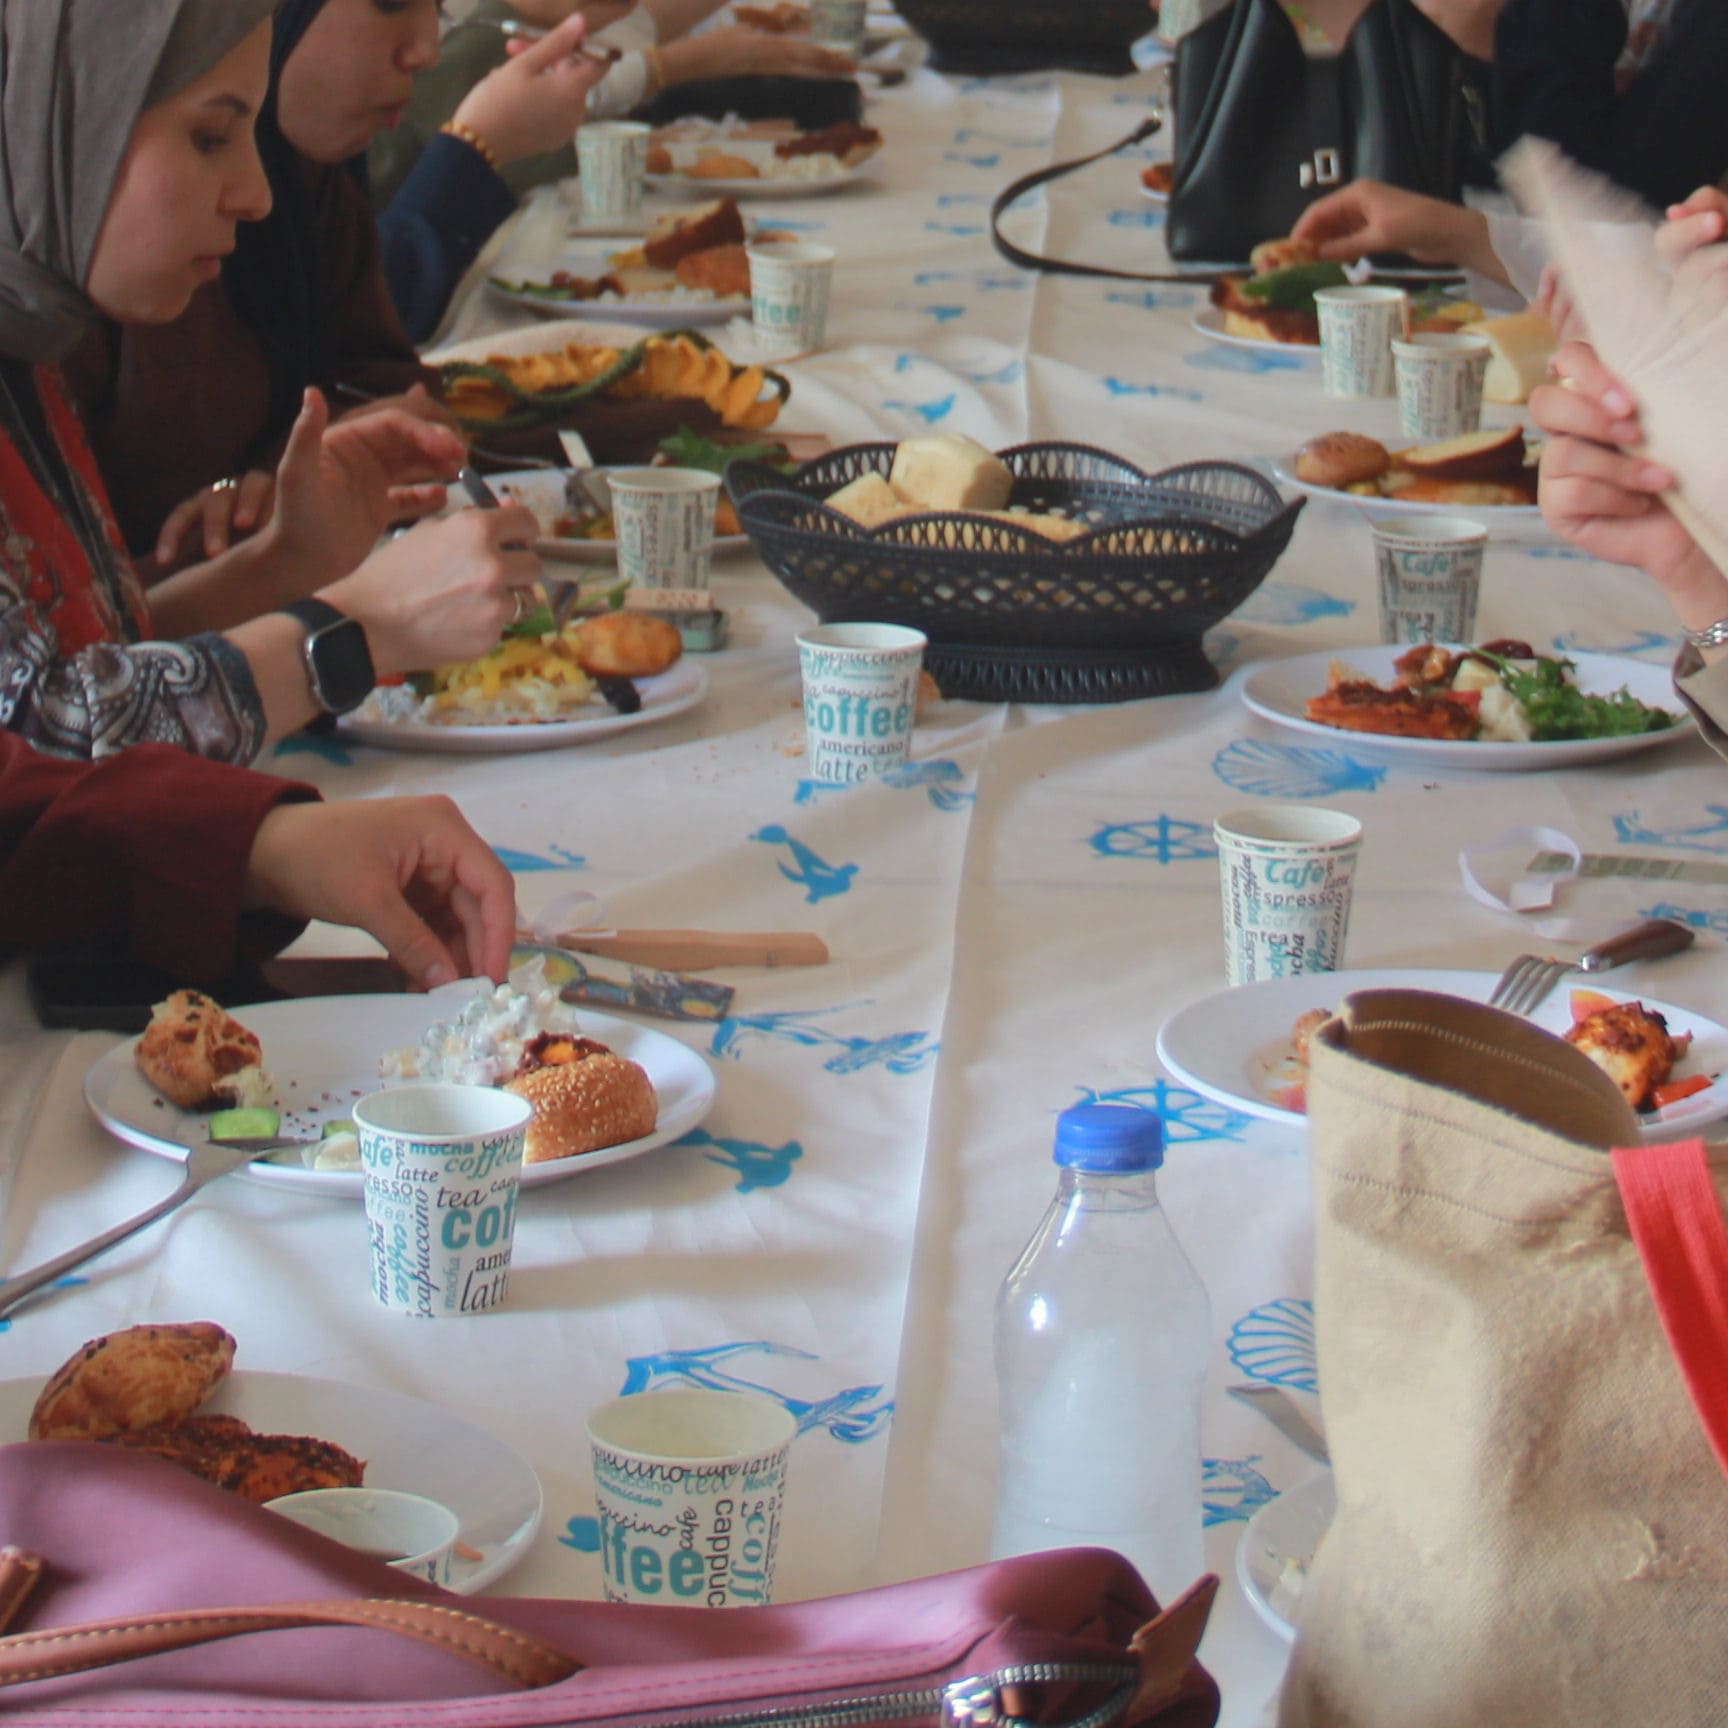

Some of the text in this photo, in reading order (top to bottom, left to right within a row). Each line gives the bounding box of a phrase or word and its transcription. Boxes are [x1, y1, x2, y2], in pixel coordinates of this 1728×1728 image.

[806, 696, 910, 737] coffee
[814, 744, 868, 783] latte
[396, 1160, 439, 1183] latte
[437, 1187, 488, 1209] tea
[675, 1505, 701, 1551] cafe
[741, 1496, 777, 1517] tea
